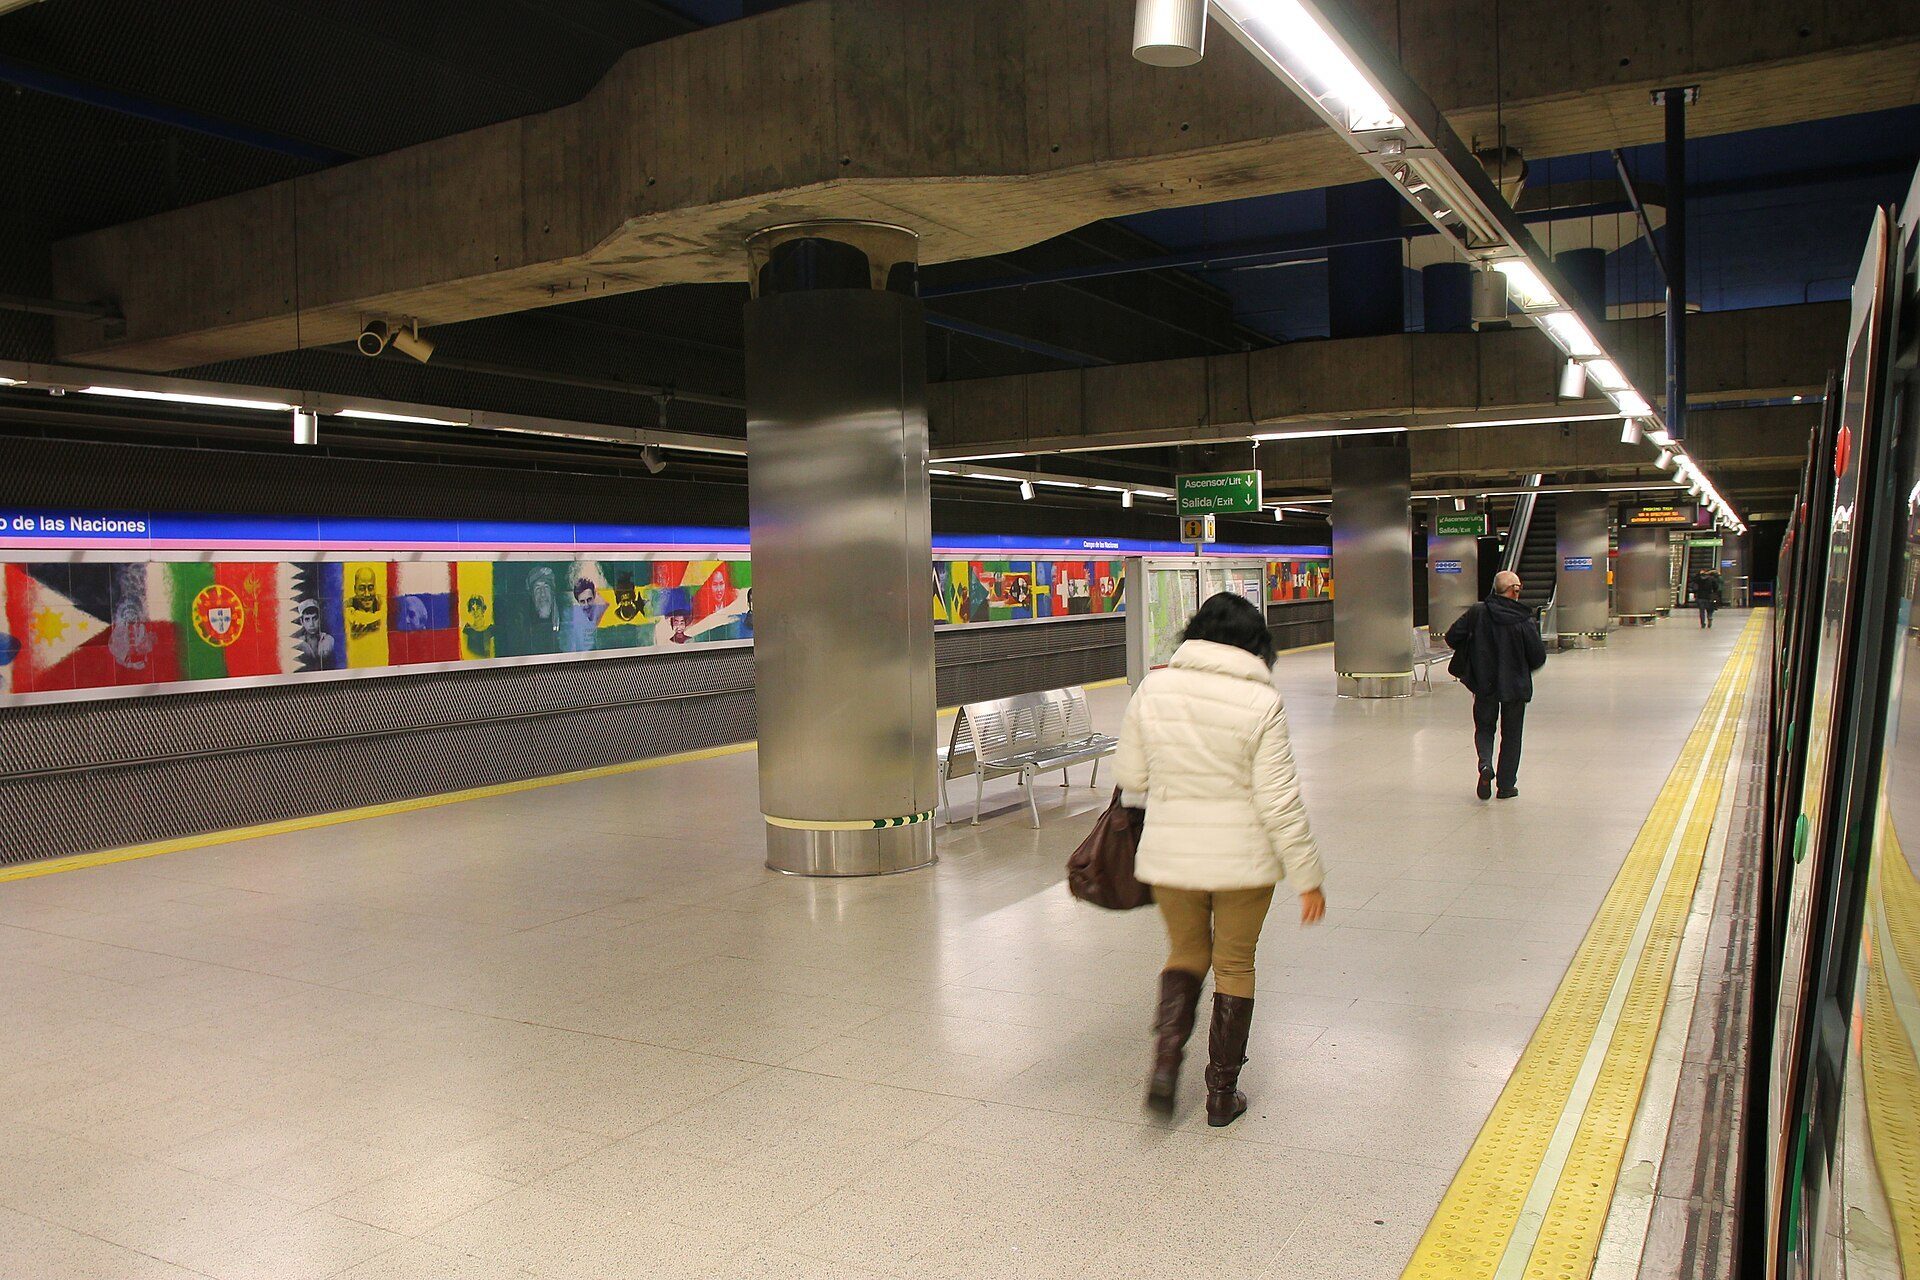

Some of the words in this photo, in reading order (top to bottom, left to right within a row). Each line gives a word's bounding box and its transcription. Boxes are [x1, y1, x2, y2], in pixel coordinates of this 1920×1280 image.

[1184, 477, 1241, 488] Ascensor/Lift
[1181, 495, 1234, 508] Salida/Exit
[12, 515, 35, 531] de
[40, 515, 65, 531] las
[70, 516, 146, 532] Naciones
